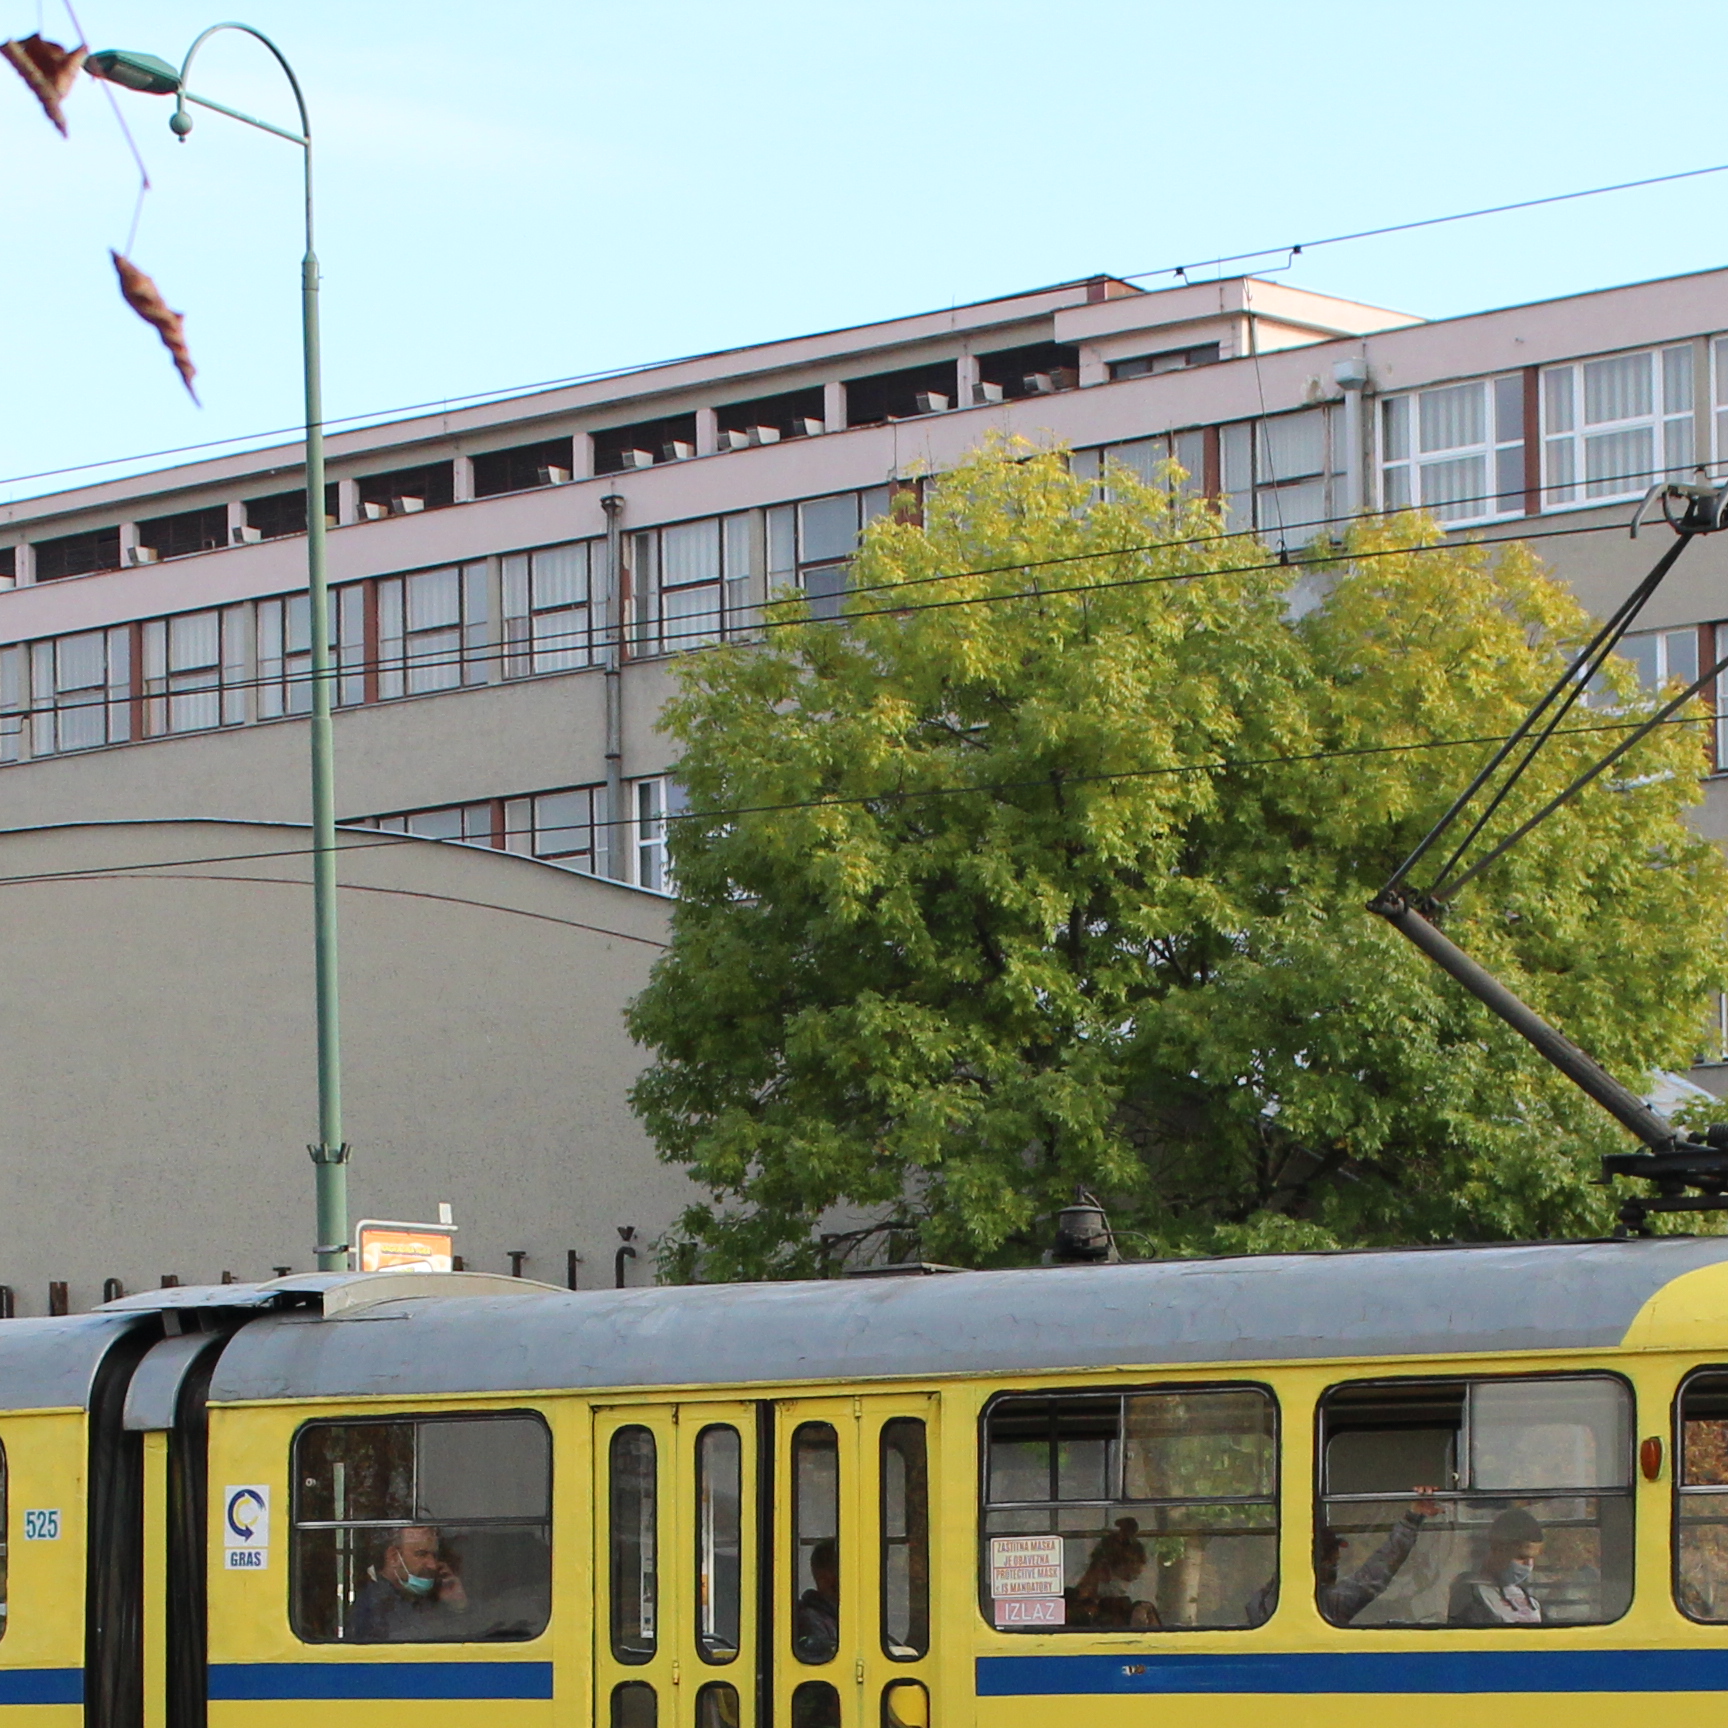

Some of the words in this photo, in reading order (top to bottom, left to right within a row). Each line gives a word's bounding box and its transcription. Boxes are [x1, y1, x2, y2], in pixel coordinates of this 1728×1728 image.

[25, 1510, 59, 1540] 525
[1031, 1540, 1056, 1551] MASKA
[230, 1551, 261, 1567] GRAS
[1013, 1554, 1050, 1566] OBAVEZNA
[995, 1569, 1036, 1580] PROTECTIVE
[1037, 1567, 1058, 1578] MASK
[1010, 1582, 1053, 1593] MANDATORY
[1005, 1602, 1055, 1620] IZLAZ
